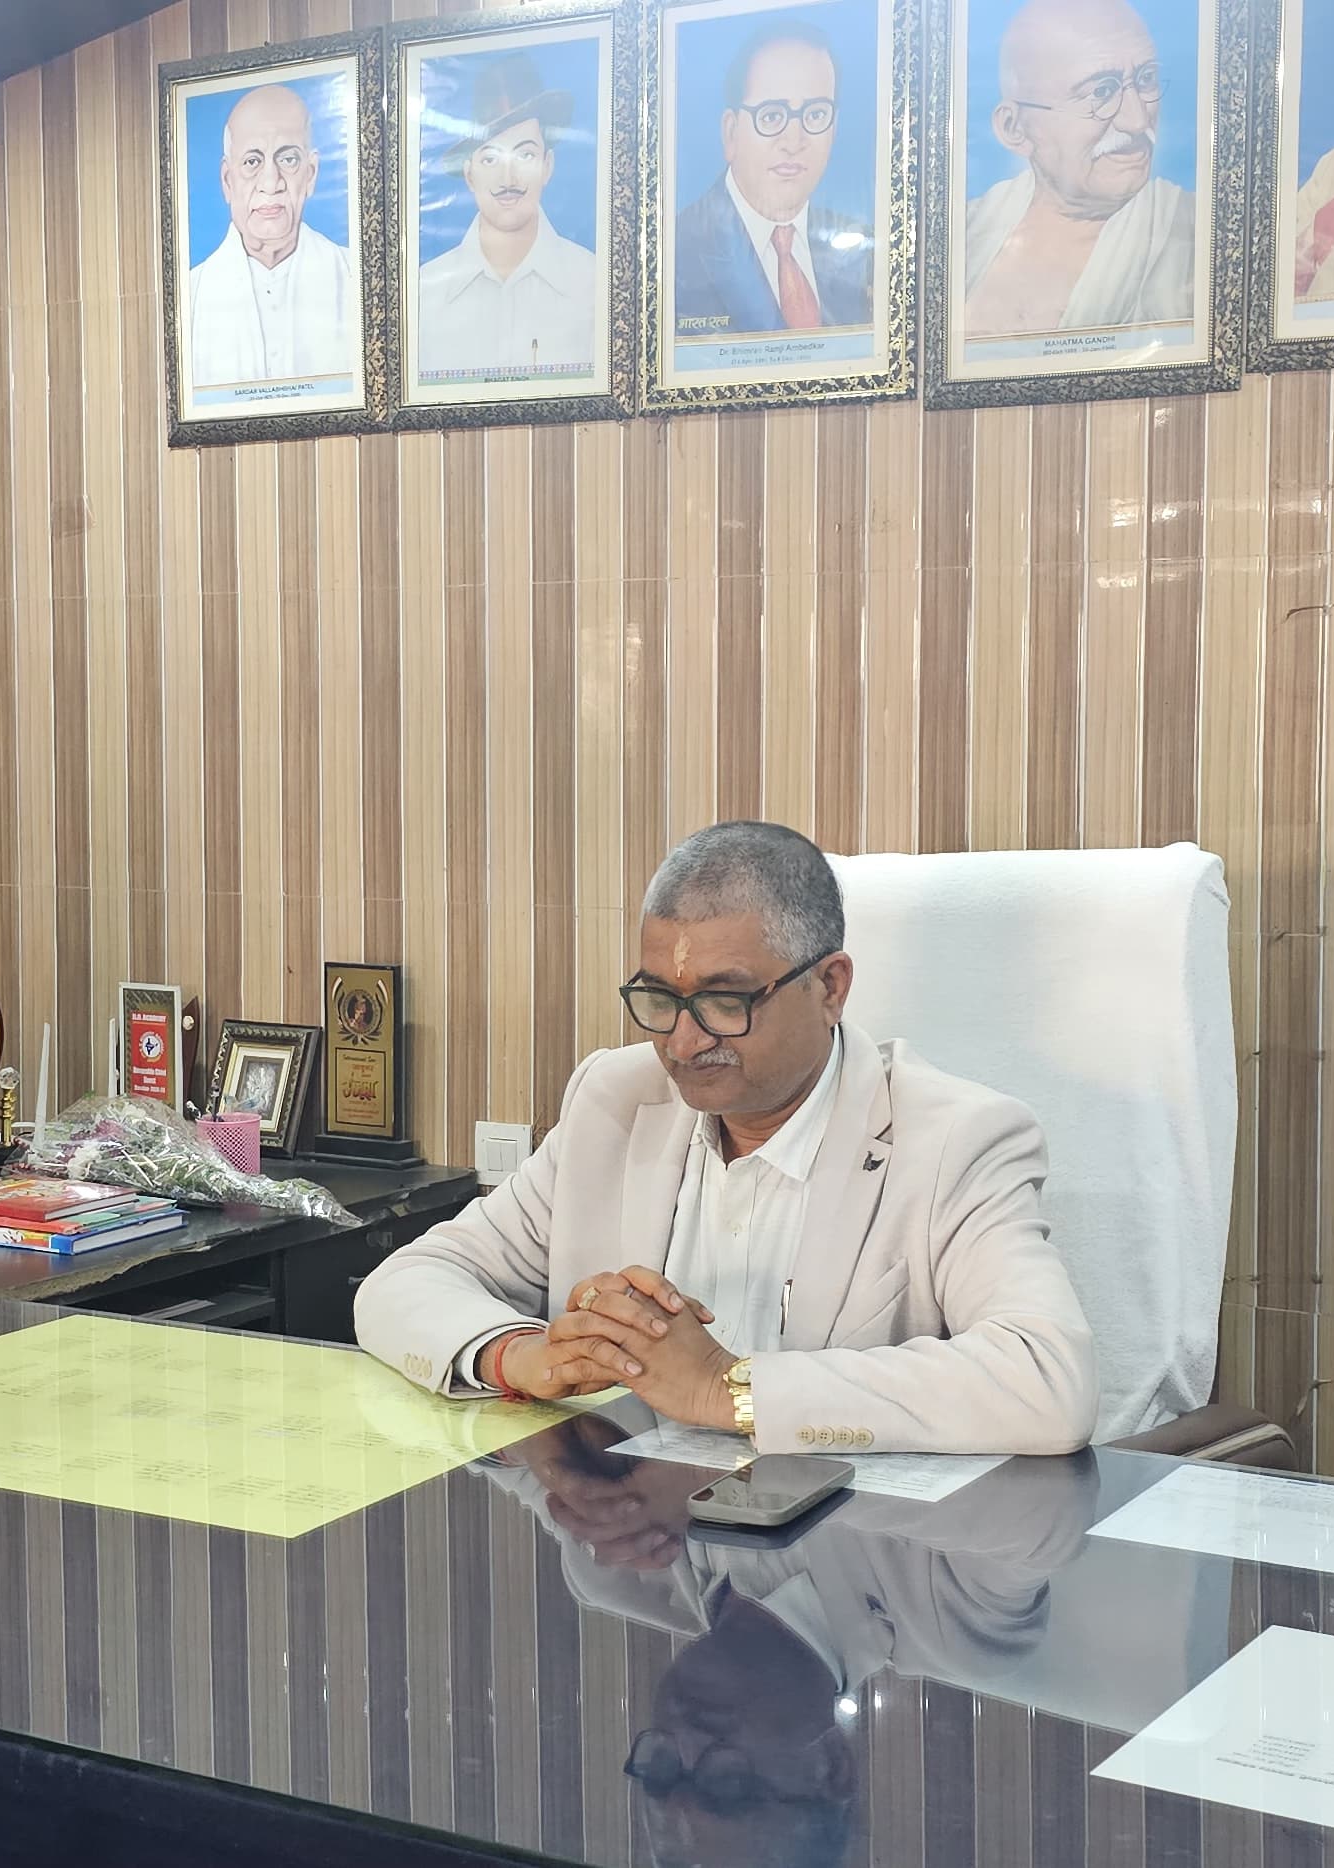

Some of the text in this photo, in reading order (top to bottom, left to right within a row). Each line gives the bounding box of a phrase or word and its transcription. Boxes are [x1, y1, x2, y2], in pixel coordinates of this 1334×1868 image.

[677, 315, 730, 329] भारत रत्न
[1044, 335, 1116, 347] MAHATMA GANDHI
